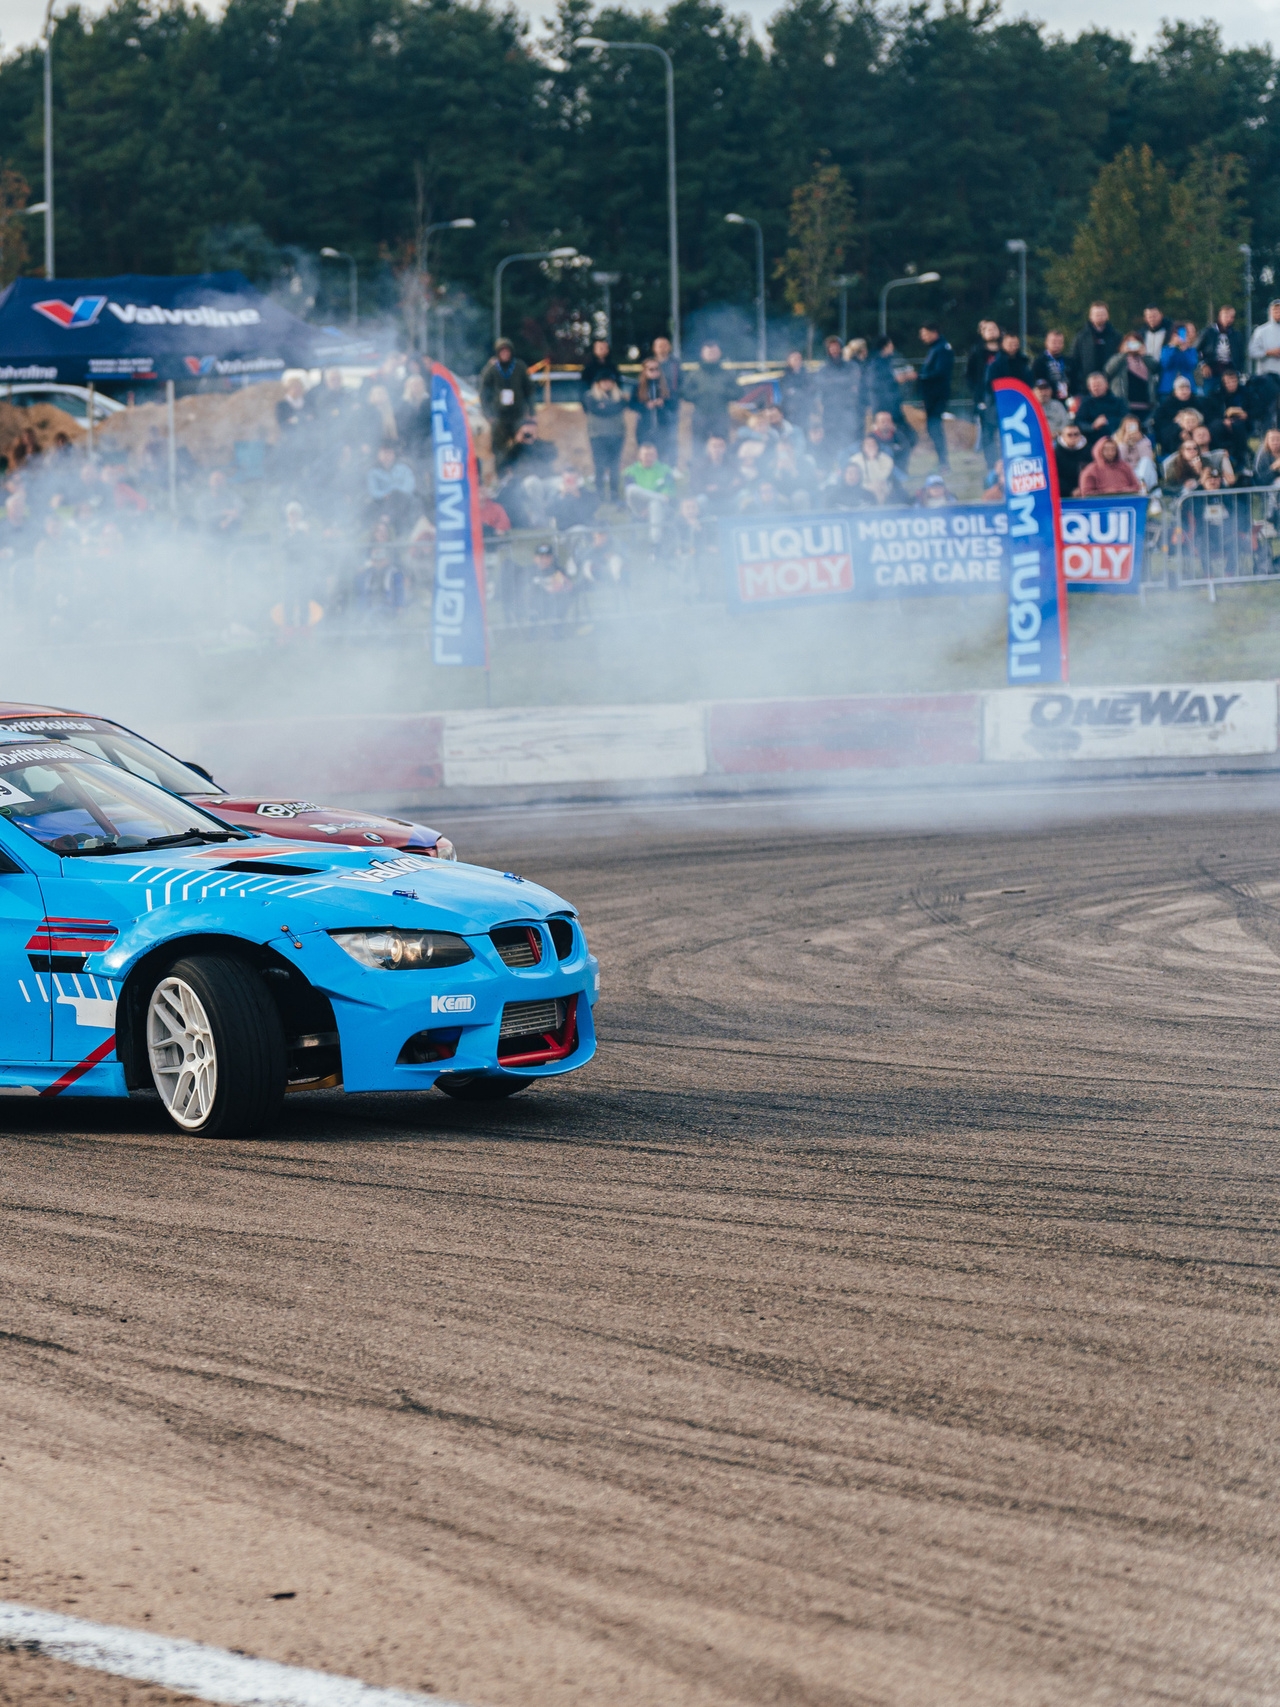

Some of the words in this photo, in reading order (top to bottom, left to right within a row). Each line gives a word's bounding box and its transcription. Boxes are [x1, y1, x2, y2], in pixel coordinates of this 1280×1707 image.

[107, 302, 261, 328] Valvoline
[858, 519, 947, 541] MOTOR
[952, 513, 1008, 536] OILS
[739, 525, 844, 561] LIQUI
[870, 537, 1003, 563] ADDITIVES
[875, 564, 927, 586] CAR
[932, 560, 1002, 583] CARE
[1063, 546, 1132, 578] OLY
[742, 559, 847, 596] MOLY
